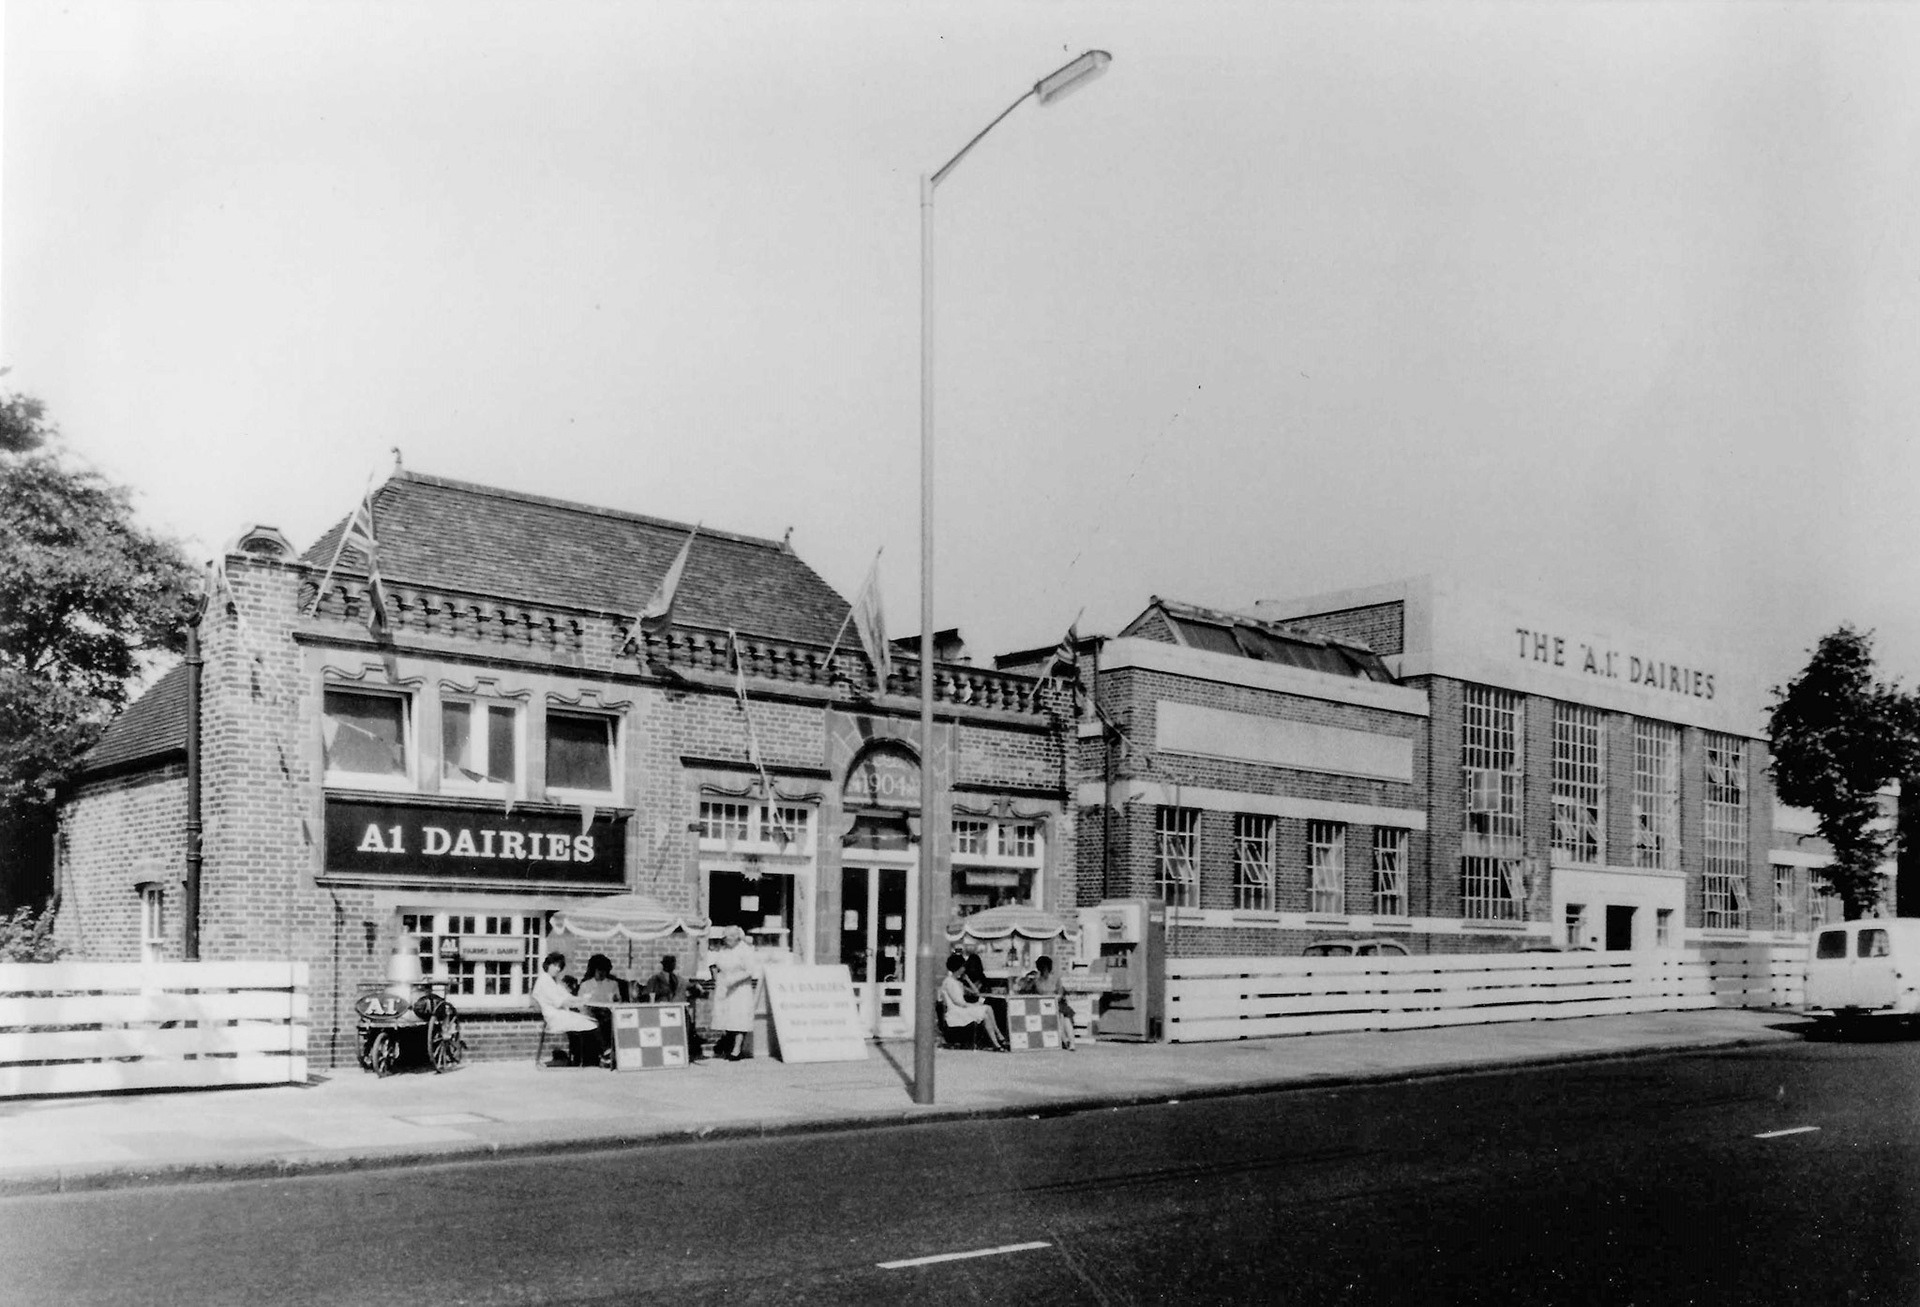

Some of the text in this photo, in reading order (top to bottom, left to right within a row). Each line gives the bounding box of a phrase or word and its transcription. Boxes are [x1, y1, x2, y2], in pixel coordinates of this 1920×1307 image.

[1515, 627, 1566, 667] THE
[1630, 655, 1717, 701] DAIRIES
[862, 772, 907, 797] 1904
[357, 823, 596, 863] A1 DAIRIES
